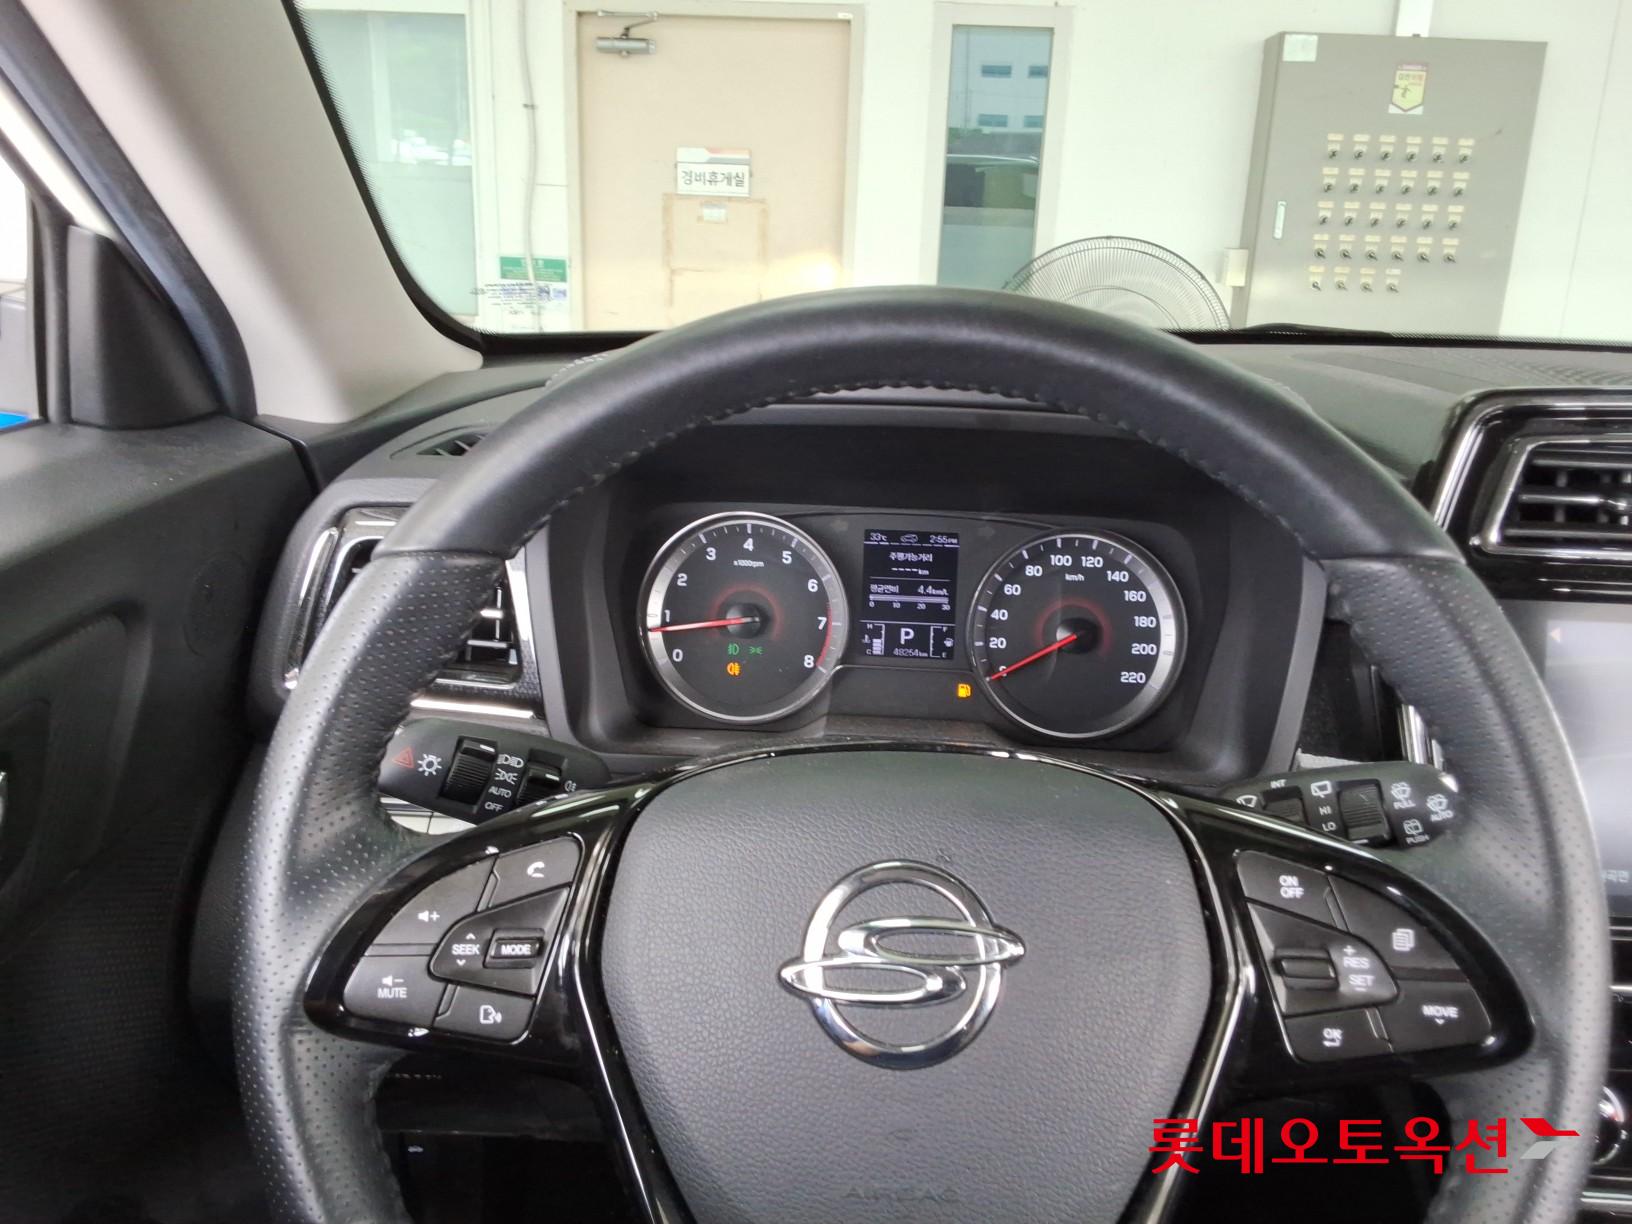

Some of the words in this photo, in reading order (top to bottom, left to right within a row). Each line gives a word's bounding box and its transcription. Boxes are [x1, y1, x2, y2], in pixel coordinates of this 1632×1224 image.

[681, 170, 745, 187] 경비휴게실
[743, 538, 754, 551] 4
[705, 547, 716, 560] 3
[782, 551, 792, 564] 5
[1050, 555, 1072, 567] 100
[1081, 556, 1103, 568] 120
[1025, 566, 1043, 577] 80
[1065, 573, 1085, 582] km/h
[1107, 571, 1129, 582] 140
[676, 573, 687, 587] 2
[807, 578, 818, 592] 6
[1004, 584, 1022, 596] 60
[1124, 590, 1147, 602] 160
[664, 610, 671, 622] 1
[990, 609, 1008, 621] 40
[817, 616, 827, 630] 7
[1134, 616, 1157, 628] 180
[900, 627, 915, 645] P
[989, 638, 1007, 649] 20
[1131, 643, 1157, 656] 200
[672, 649, 683, 662] 0
[804, 655, 815, 668] 8
[1120, 672, 1146, 684] 220
[1270, 779, 1287, 789] INT
[488, 785, 512, 798] AUTO
[484, 801, 504, 812] OFF
[1319, 806, 1332, 816] HI
[1321, 822, 1337, 832] LO
[1279, 875, 1299, 887] ON
[1280, 887, 1304, 898] OFF
[452, 944, 480, 955] SEEK
[501, 944, 532, 955] MODE
[1343, 957, 1370, 969] RES
[1349, 974, 1375, 986] SET
[377, 987, 408, 999] MUTE
[1421, 1005, 1459, 1018] MOVE
[1323, 1028, 1342, 1039] OK
